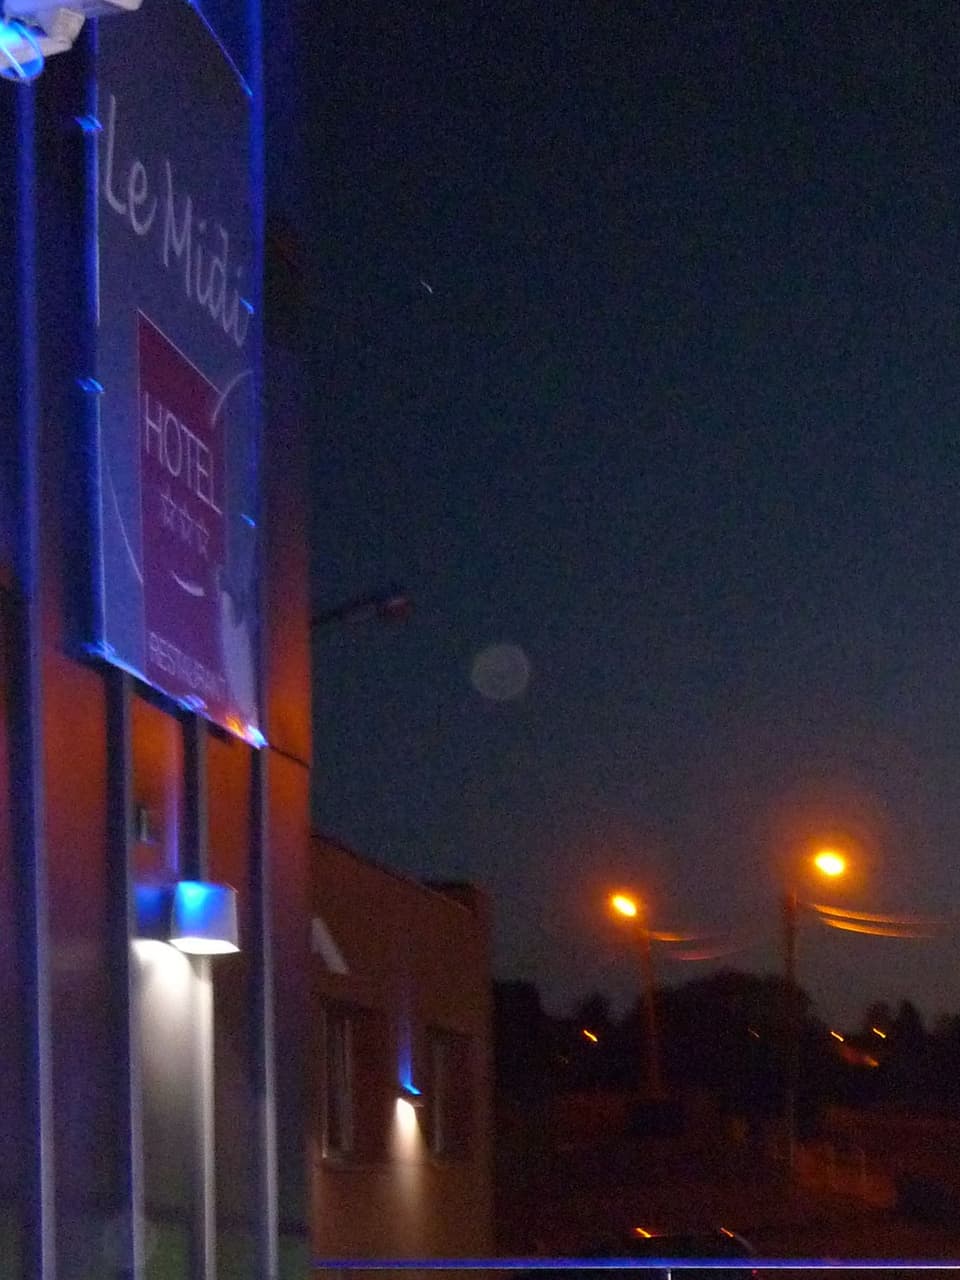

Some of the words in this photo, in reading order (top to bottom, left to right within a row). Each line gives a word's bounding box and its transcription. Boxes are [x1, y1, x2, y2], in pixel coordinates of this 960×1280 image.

[104, 94, 158, 236] Le
[162, 159, 251, 348] Midi
[144, 390, 224, 517] HOTEL
